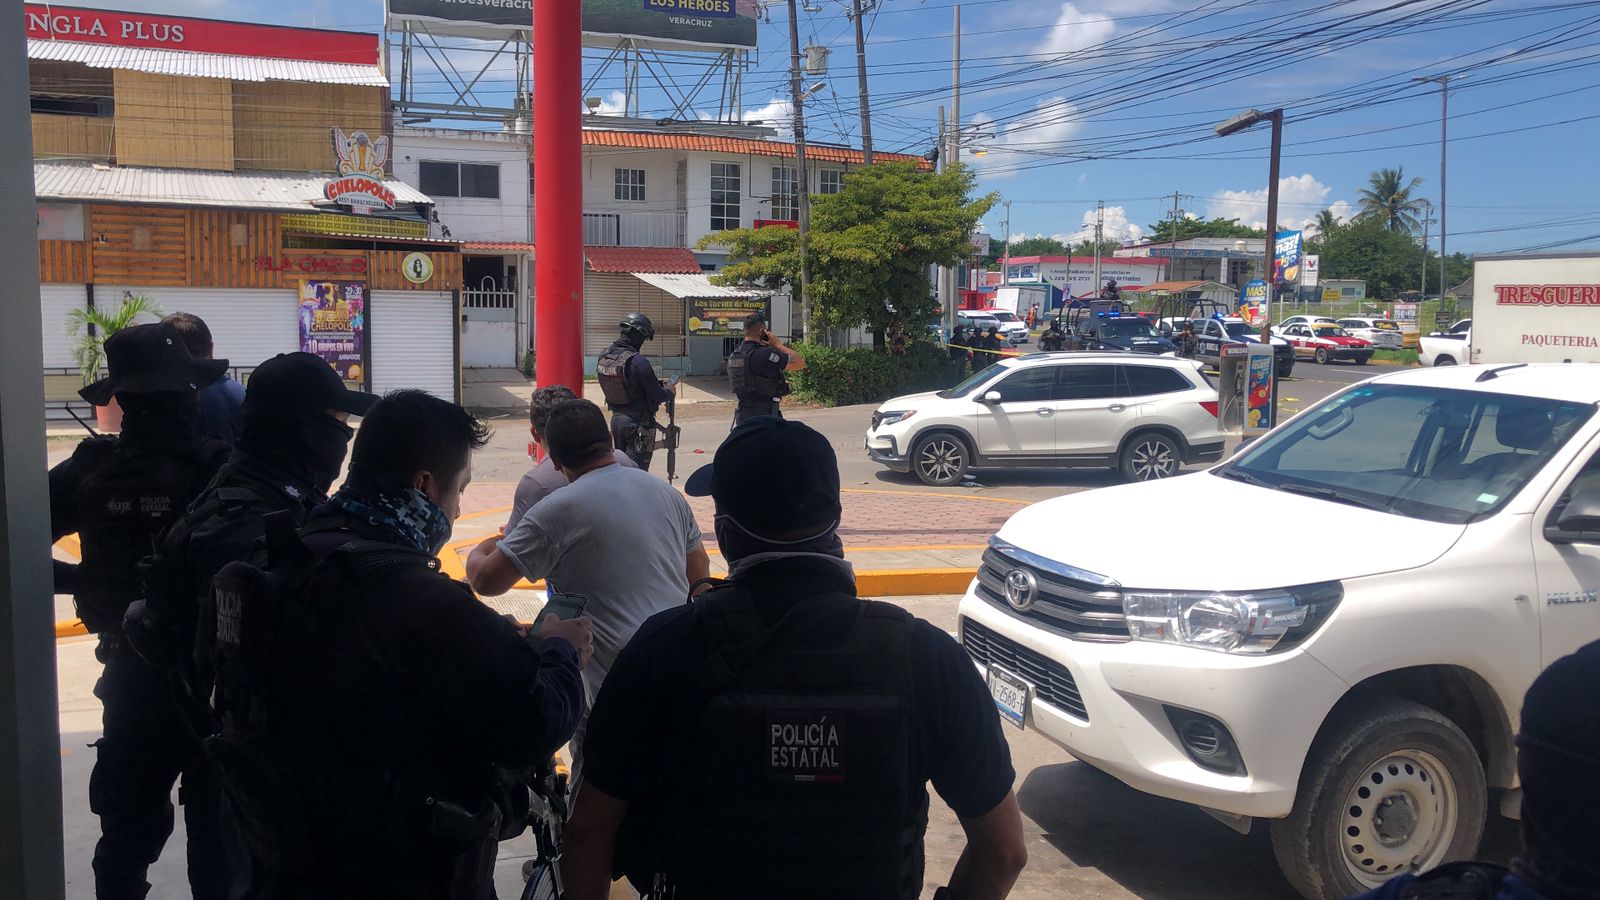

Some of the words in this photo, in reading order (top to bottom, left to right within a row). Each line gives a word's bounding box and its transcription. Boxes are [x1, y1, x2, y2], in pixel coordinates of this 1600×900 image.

[25, 12, 108, 37] NGLA
[120, 20, 184, 43] PLUS
[669, 16, 713, 28] VERACRUZ
[328, 178, 396, 206] CHELOPOLIS
[1495, 285, 1600, 307] TRESGUER
[311, 322, 353, 332] CHELOPOLIS
[307, 339, 318, 353] 10
[1521, 334, 1598, 347] PAQUETERIA
[771, 716, 839, 746] POLICÍA
[771, 746, 840, 768] ESTATAL
